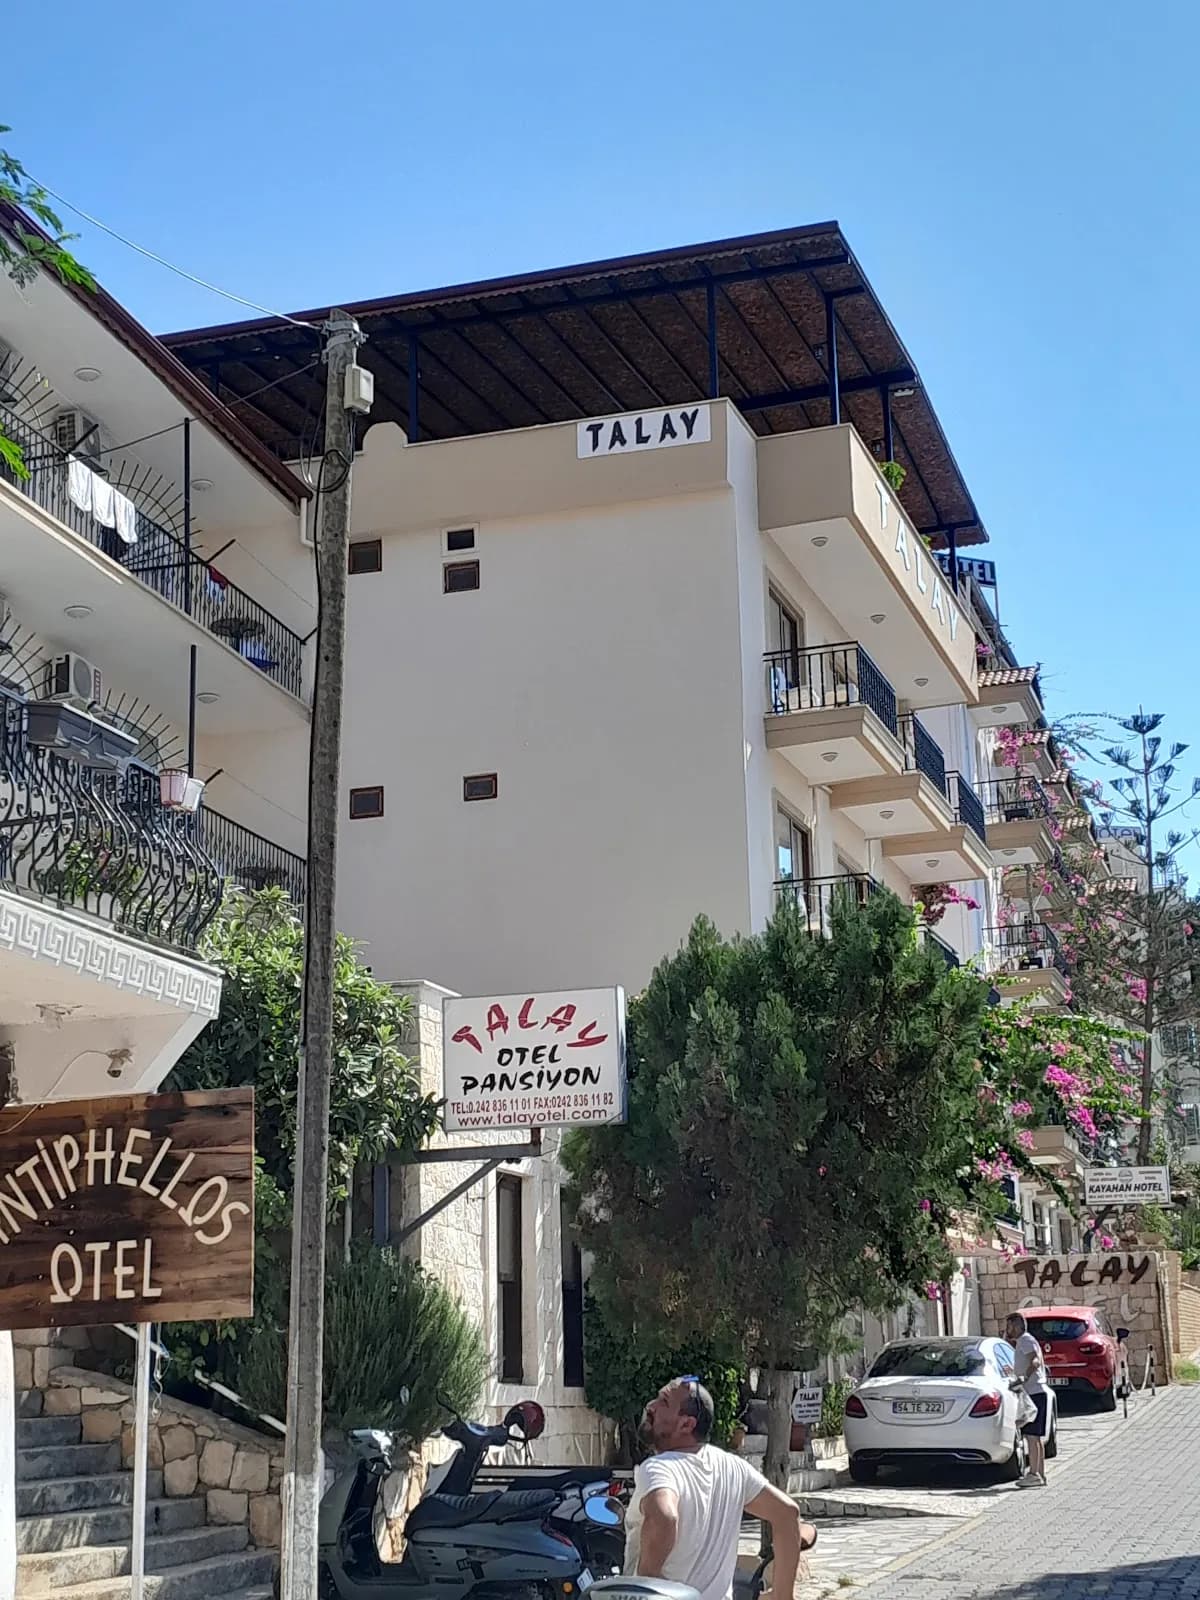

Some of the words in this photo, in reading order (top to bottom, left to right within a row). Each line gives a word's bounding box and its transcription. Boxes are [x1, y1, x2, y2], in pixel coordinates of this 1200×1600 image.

[586, 408, 699, 452] TALAY
[875, 480, 960, 641] TALAY
[452, 998, 608, 1053] TALAY
[497, 1044, 561, 1066] OTEL
[493, 1099, 507, 1112] 836
[510, 1099, 519, 1111] 11
[521, 1098, 531, 1110] 01
[534, 1095, 571, 1109] FAX:0242
[574, 1094, 588, 1106] 836
[592, 1093, 601, 1105] 11
[603, 1092, 613, 1105] 82
[458, 1108, 607, 1126] www.talayotel.com
[0, 1128, 250, 1245] NTİPHELLOS
[1088, 1183, 1132, 1193] KAYAHAN
[1133, 1182, 1163, 1192] HOTEL
[50, 1238, 162, 1303] OTEL
[800, 1392, 819, 1400] TALAY
[898, 1403, 908, 1412] 54
[912, 1403, 922, 1412] TE
[925, 1403, 942, 1412] 222
